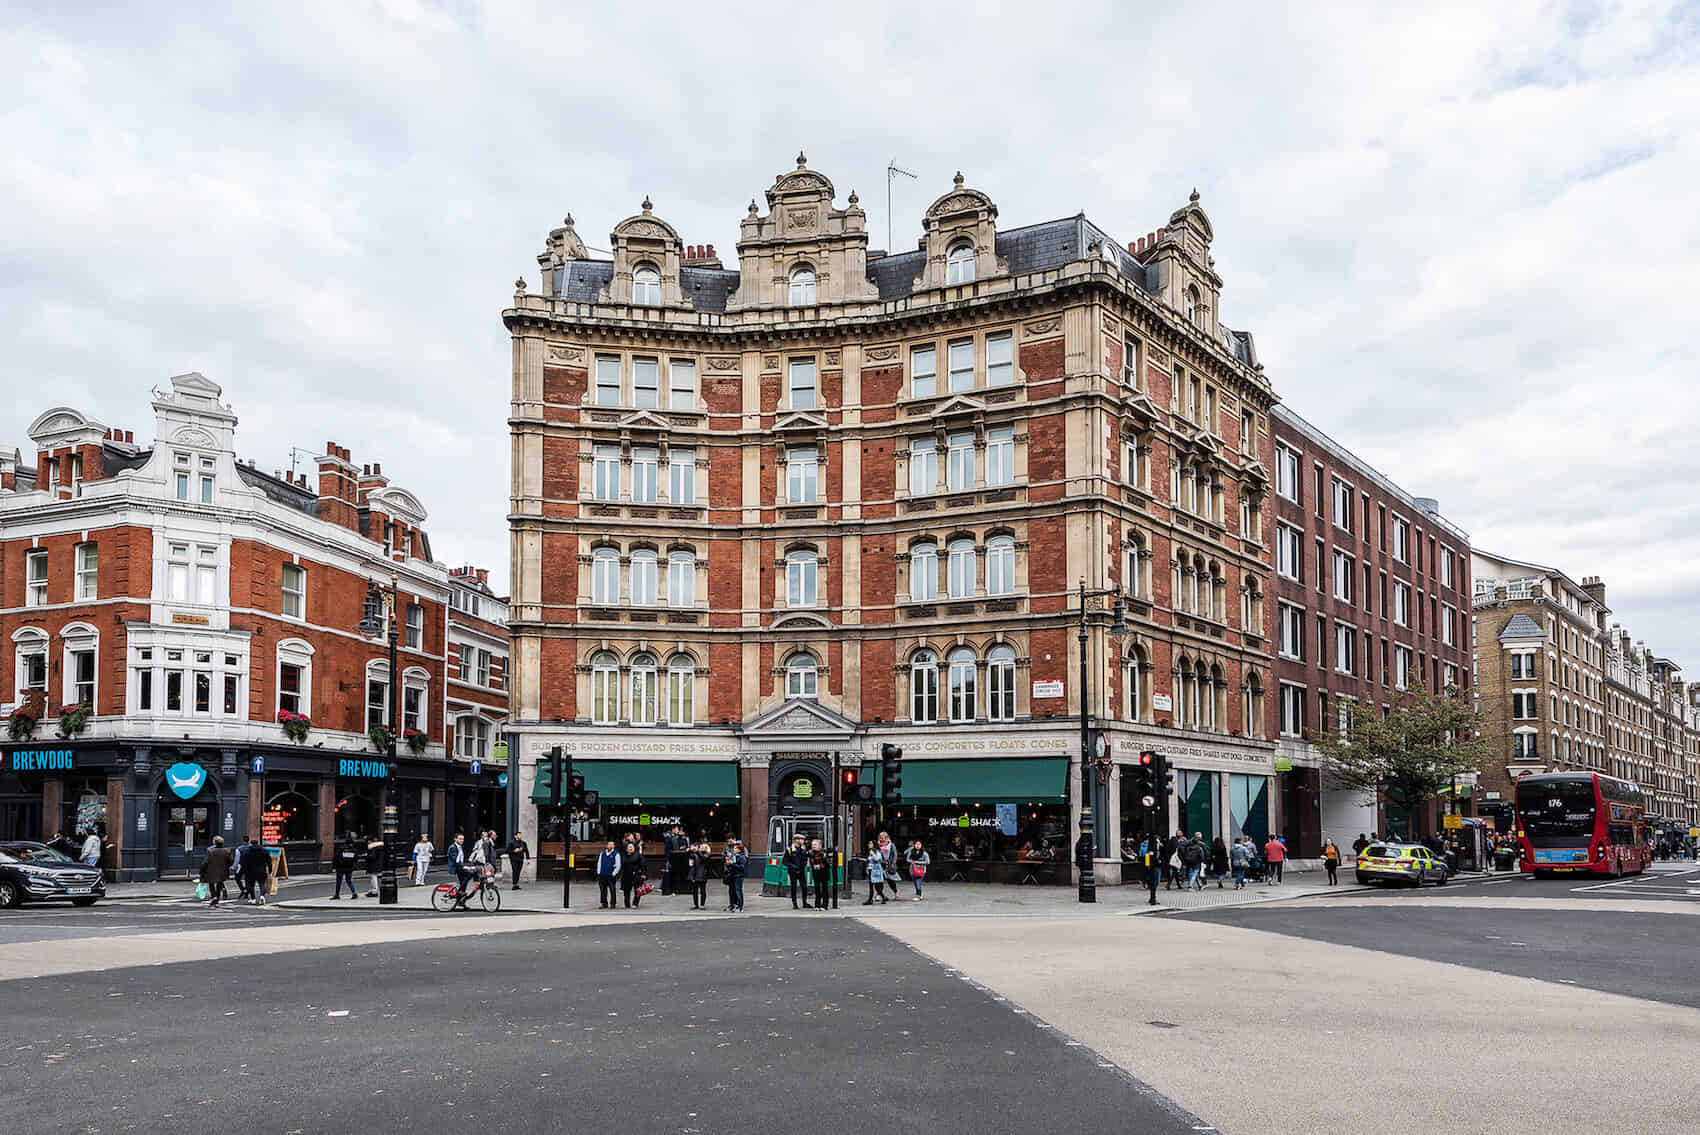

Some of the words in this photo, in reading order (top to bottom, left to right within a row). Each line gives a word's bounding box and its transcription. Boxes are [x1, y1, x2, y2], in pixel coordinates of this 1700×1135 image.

[531, 742, 577, 751] BURERS
[581, 743, 620, 752] FROZEN
[622, 743, 665, 753] CUSTARD
[669, 743, 695, 753] FRIES
[699, 743, 737, 753] SHAKES
[925, 741, 985, 751] CONCRETES
[989, 740, 1026, 750] FLOATS
[1030, 739, 1068, 749] CONES
[12, 750, 73, 770] BREWDOG
[339, 759, 389, 778] BREWDO
[1548, 799, 1563, 808] 176
[609, 815, 639, 825] SHAKE
[651, 815, 681, 825] SHACK
[928, 817, 958, 827] SHAKE
[970, 817, 1001, 827] SHACK
